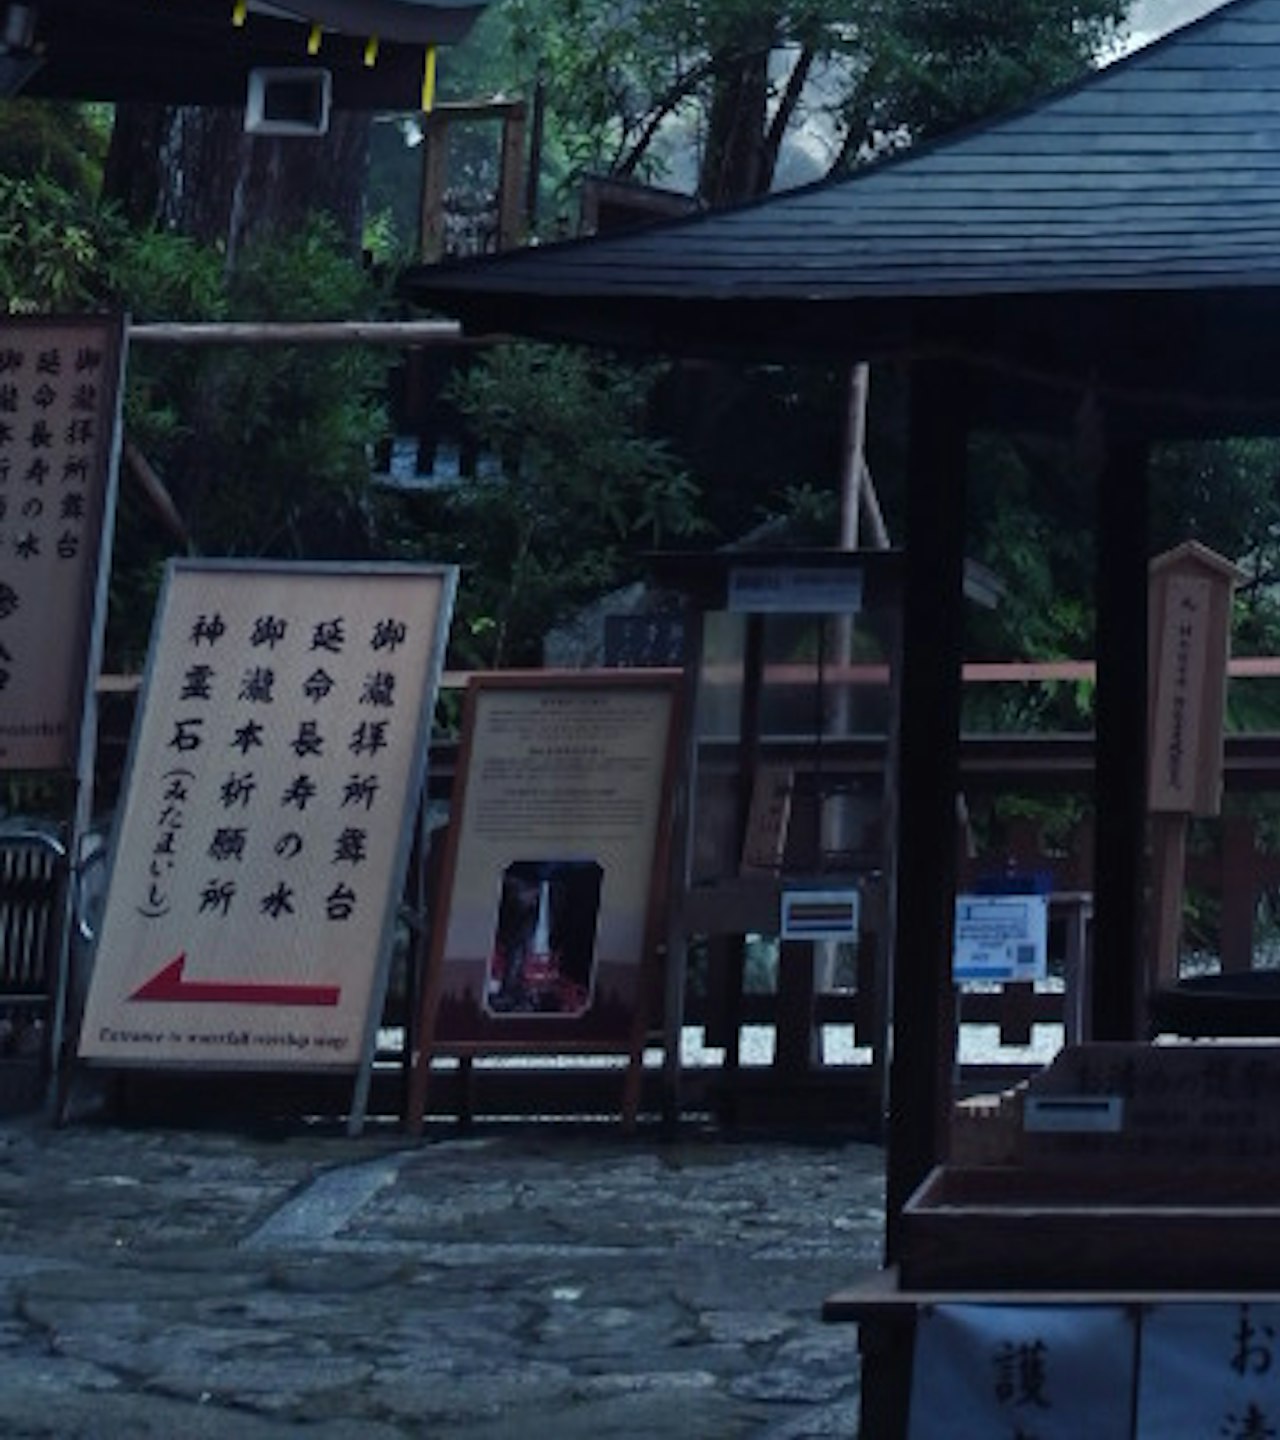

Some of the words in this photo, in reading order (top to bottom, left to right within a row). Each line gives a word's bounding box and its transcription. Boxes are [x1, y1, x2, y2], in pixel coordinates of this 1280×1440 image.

[14, 347, 61, 560] 延命長寿の水
[260, 616, 347, 919] 延命長寿の水
